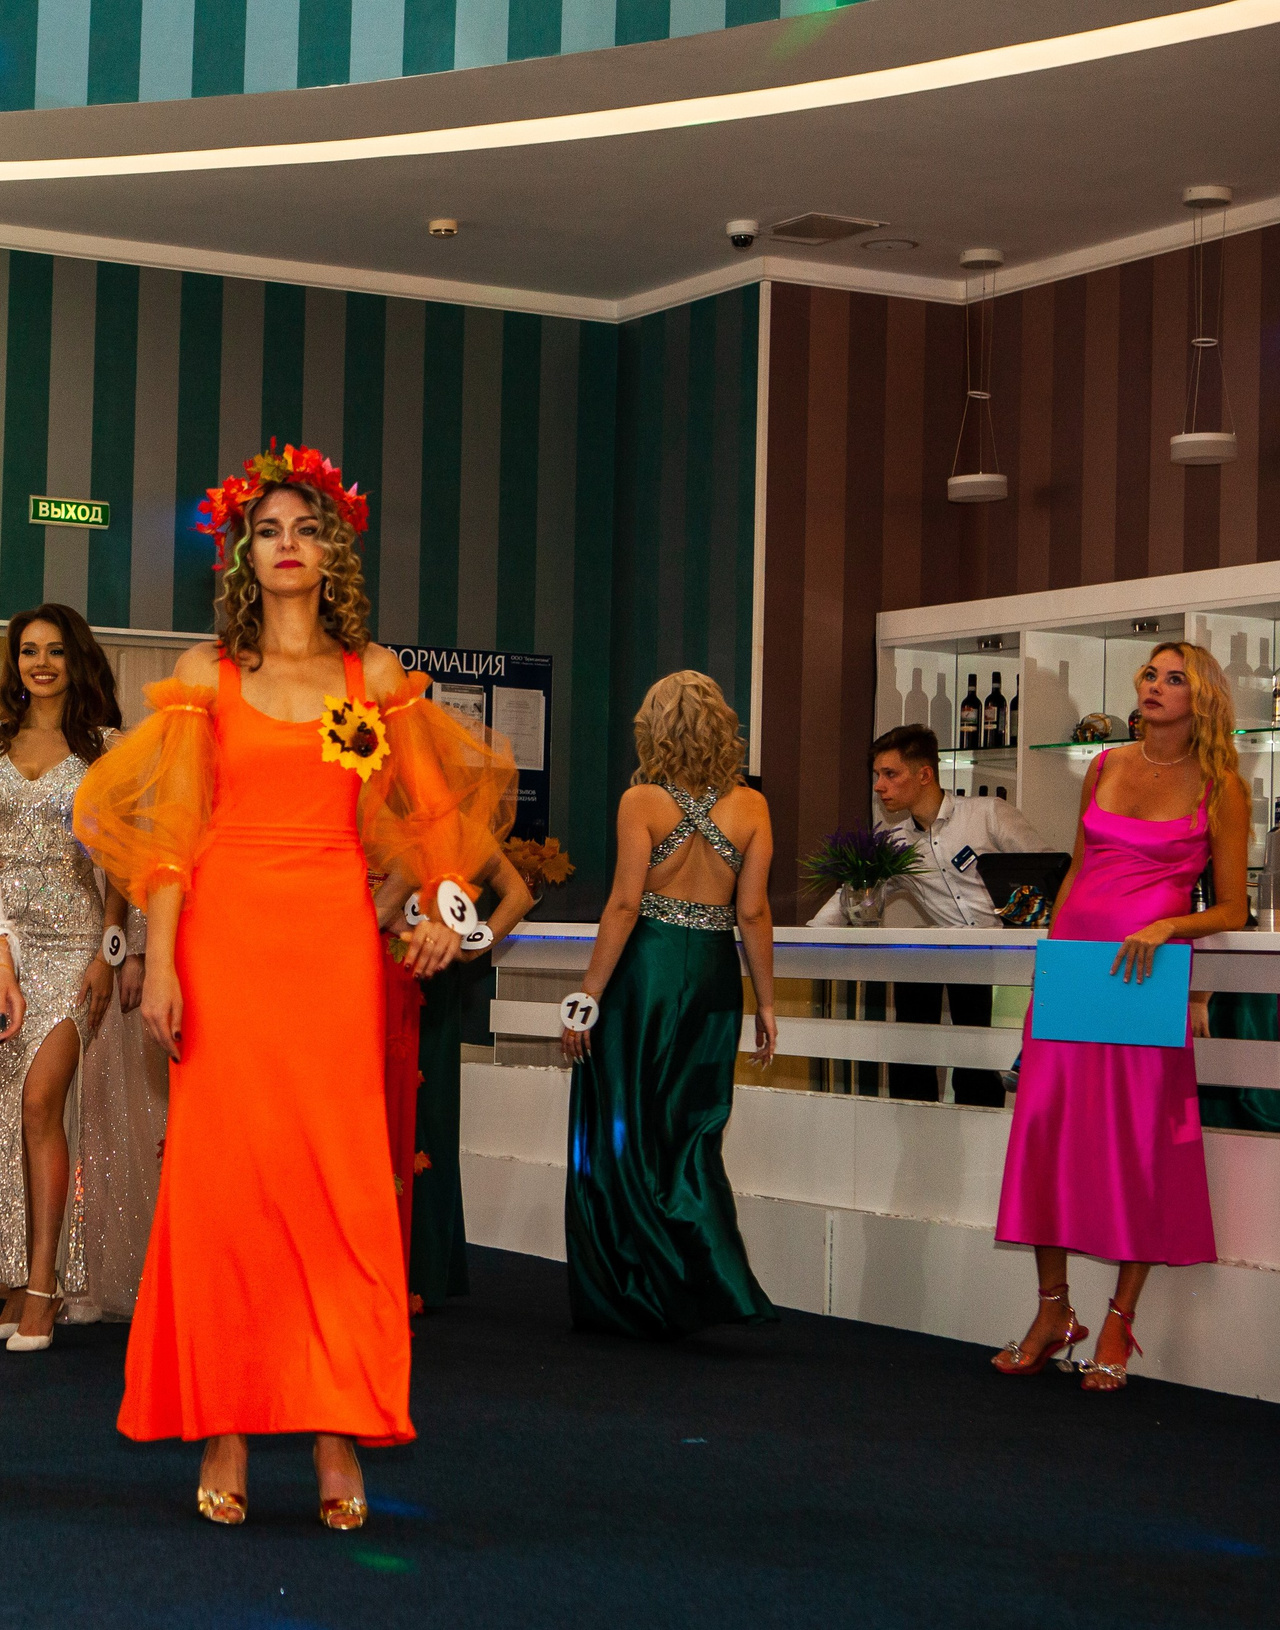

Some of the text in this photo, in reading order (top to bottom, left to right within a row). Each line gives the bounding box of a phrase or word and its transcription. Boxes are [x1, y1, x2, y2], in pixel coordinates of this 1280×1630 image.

[38, 501, 103, 523] ВЫХОД
[450, 895, 466, 922] 3
[109, 935, 121, 956] 9
[566, 1000, 593, 1025] 11
